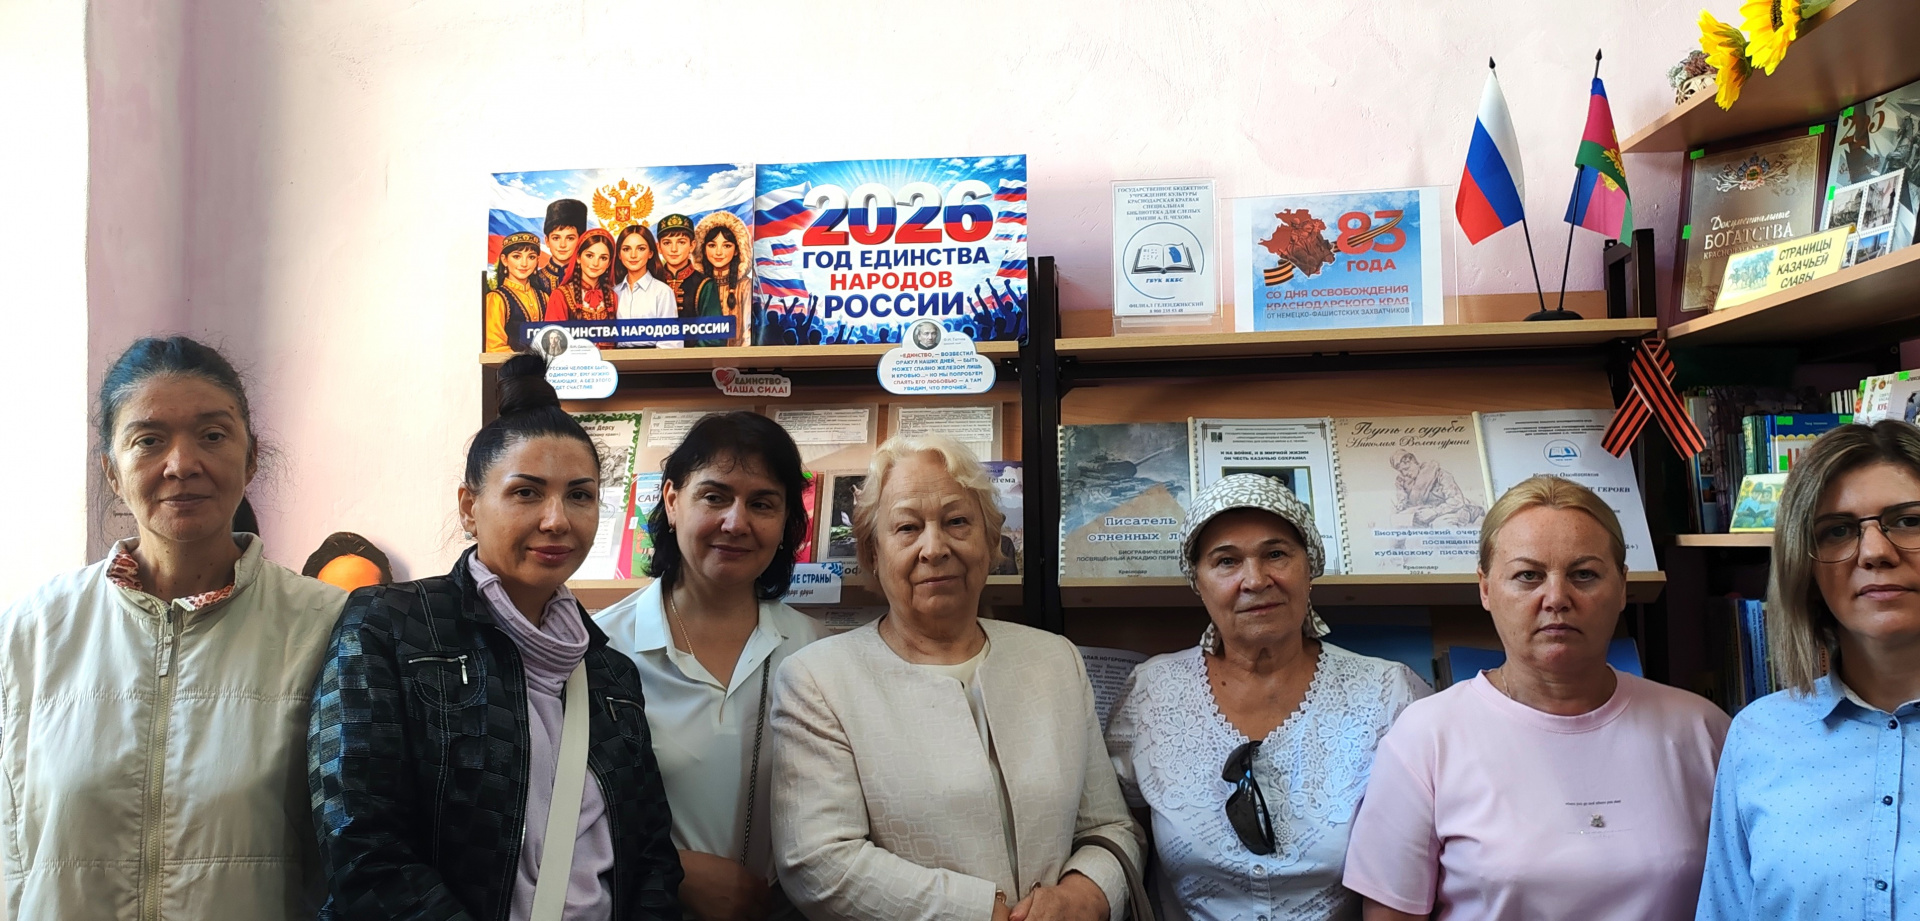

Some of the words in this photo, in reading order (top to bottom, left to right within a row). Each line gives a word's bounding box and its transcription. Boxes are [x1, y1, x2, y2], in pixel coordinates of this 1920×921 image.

[802, 179, 994, 246] 2026
[1336, 210, 1406, 255] 83
[1704, 222, 1794, 250] БОГАТСТВА
[803, 250, 852, 270] ГОД
[860, 246, 990, 270] ЕДИНСТВА
[1778, 238, 1833, 260] СТРАНИЦЫ
[1346, 258, 1396, 273] ГОДА
[1776, 254, 1830, 276] КАЗАЧЬЕЙ
[830, 271, 953, 292] НАРОДОВ
[1780, 271, 1815, 289] СЛАВЫ
[1266, 291, 1282, 299] СО
[1284, 290, 1308, 299] ДНЯ
[1311, 285, 1409, 297] ОСВОБОЖДЕНИЯ
[824, 291, 964, 318] РОССИИ
[1266, 298, 1375, 310] КРАСНОДАРСКОГО
[1379, 296, 1409, 306] КРАЯ
[1276, 308, 1359, 319] НЕМЕЦКО-ФАШИСТСКИХ
[1361, 307, 1410, 315] ЗАХВАТЧИКОВ
[621, 323, 680, 338] НАРОДОВ
[682, 322, 730, 335] РОССИИ
[1351, 421, 1400, 440] Путь
[1418, 420, 1466, 438] судьба
[1345, 437, 1396, 448] Николая
[1105, 517, 1177, 526] Писатель
[1088, 532, 1160, 542] огненных
[802, 574, 832, 584] СТРАНЫ
